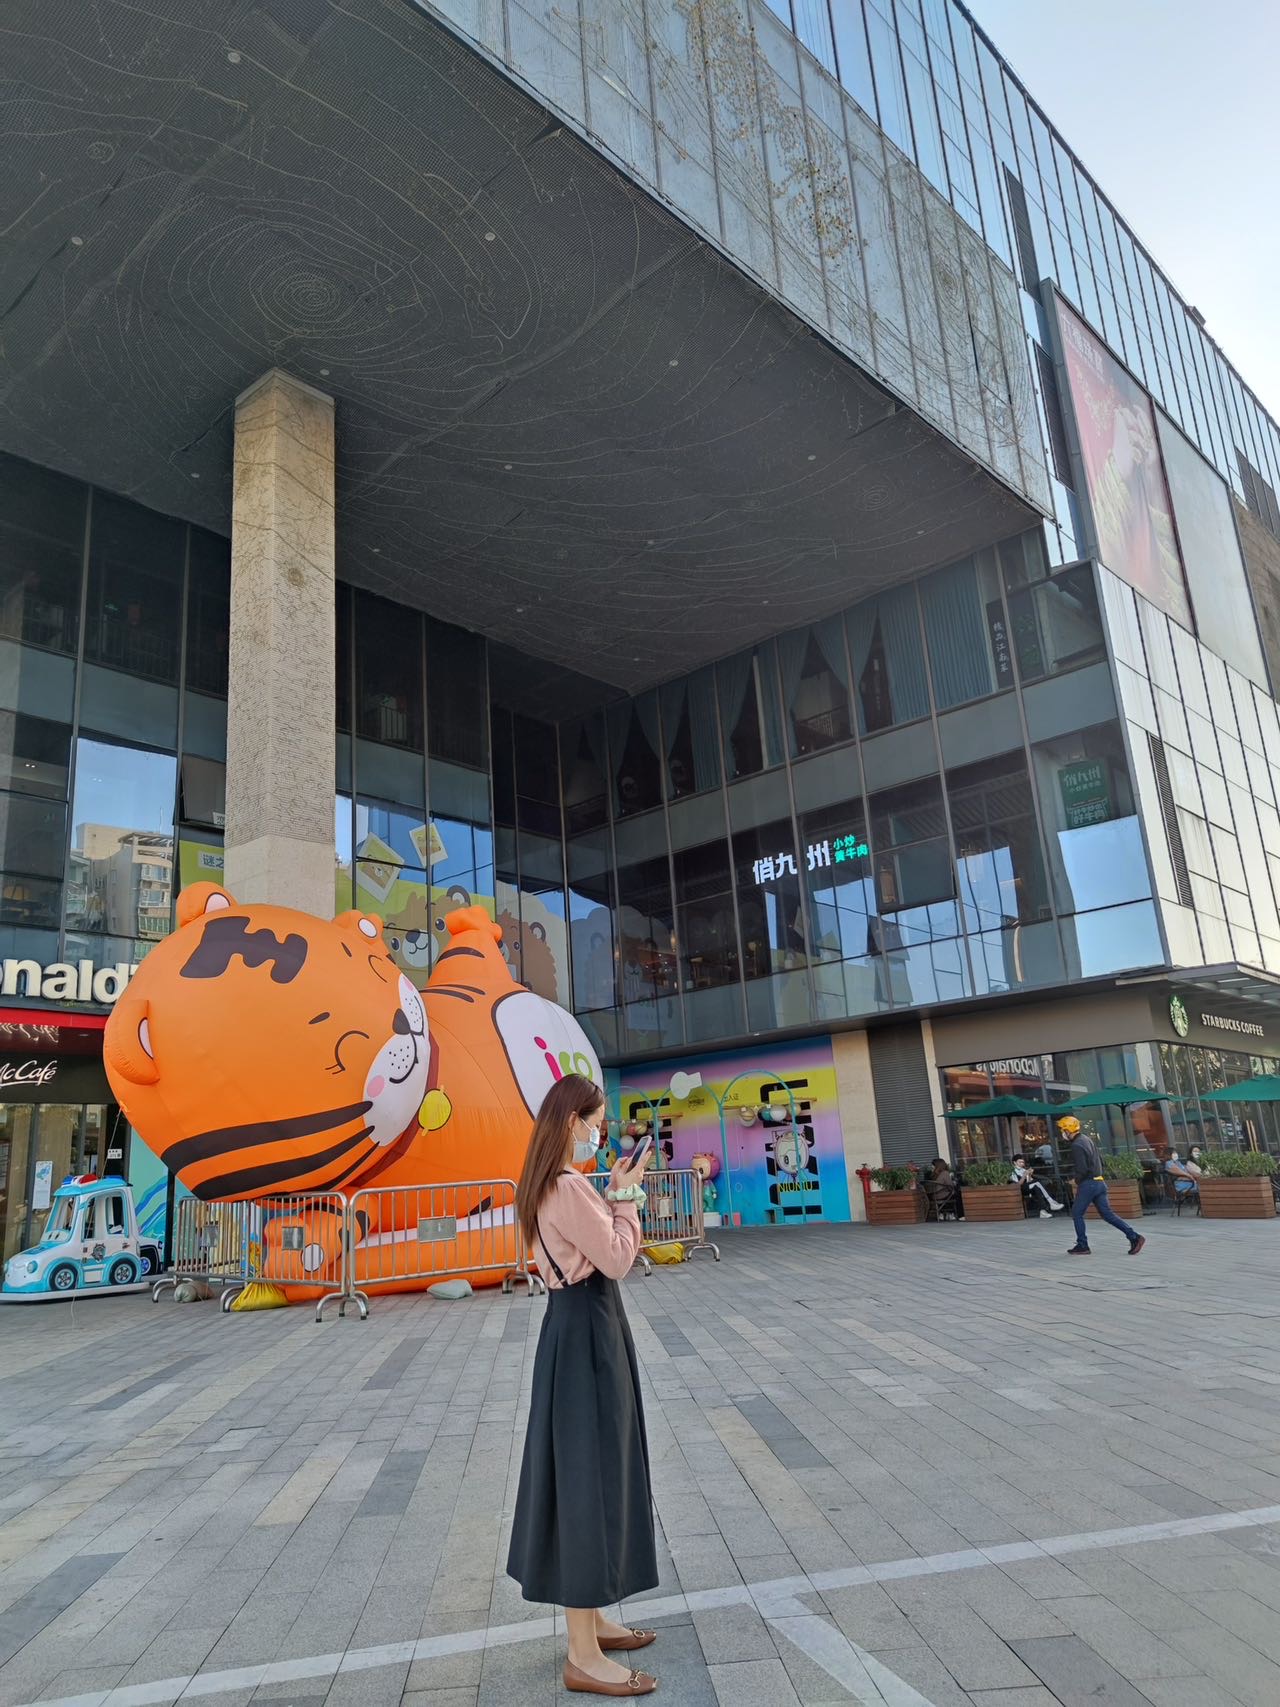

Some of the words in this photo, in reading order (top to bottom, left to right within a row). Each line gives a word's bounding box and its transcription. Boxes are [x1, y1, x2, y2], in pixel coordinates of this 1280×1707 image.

[833, 834, 857, 850] 小炒
[834, 843, 870, 864] 黄牛肉
[752, 840, 832, 885] 俏九州
[0, 959, 139, 1004] nald
[1201, 1013, 1242, 1032] STARBUCKS
[1240, 1020, 1265, 1037] COFFEE
